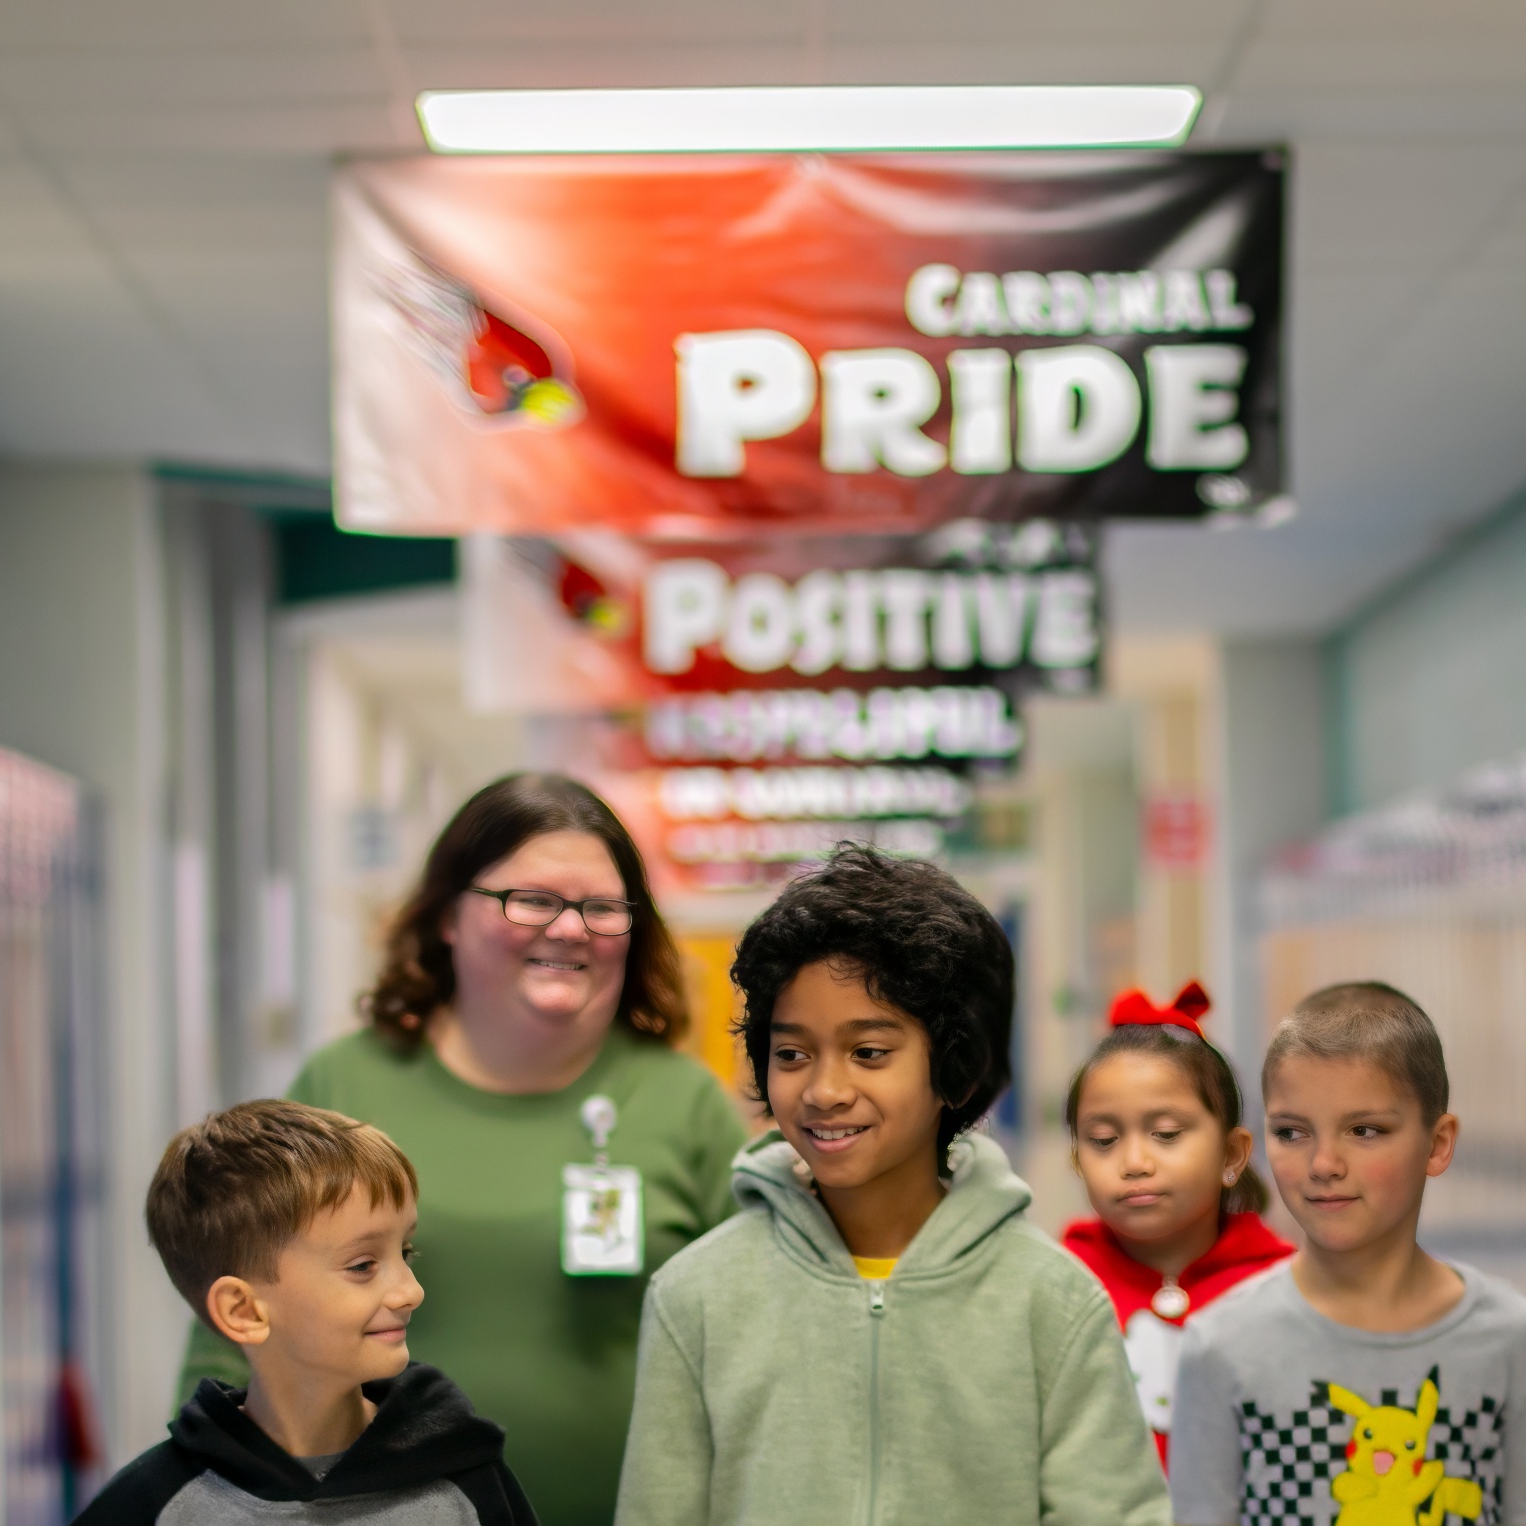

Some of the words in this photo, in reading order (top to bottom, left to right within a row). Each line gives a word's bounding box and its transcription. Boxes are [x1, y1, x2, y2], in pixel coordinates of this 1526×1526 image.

[906, 264, 1252, 335] CARDINAL
[675, 328, 1249, 477] PRIDE
[643, 558, 1098, 676] POSITIVE
